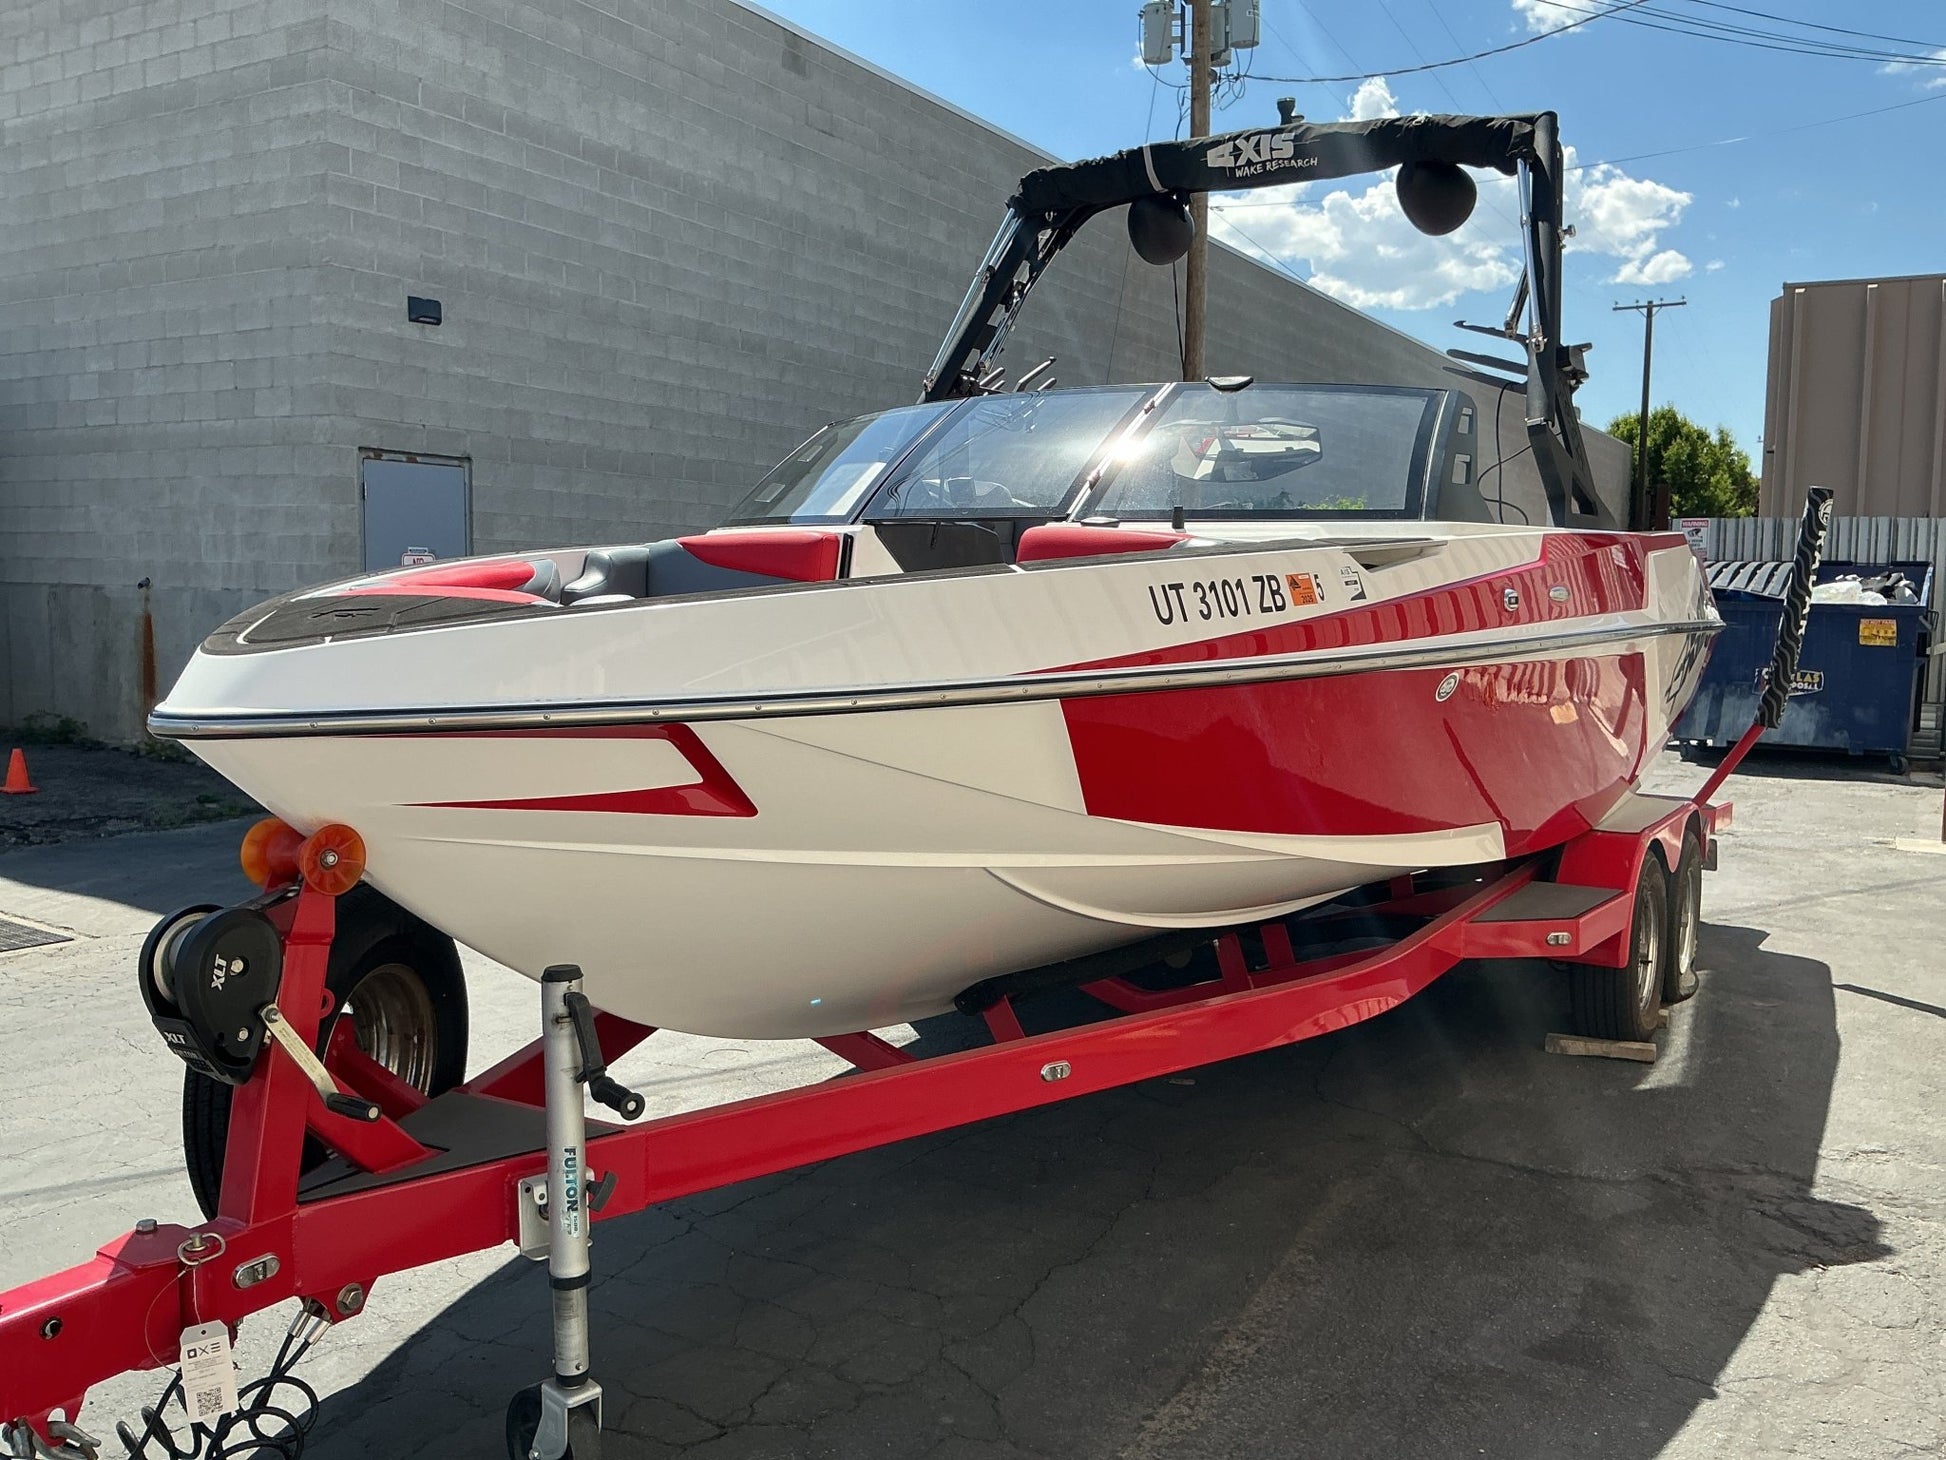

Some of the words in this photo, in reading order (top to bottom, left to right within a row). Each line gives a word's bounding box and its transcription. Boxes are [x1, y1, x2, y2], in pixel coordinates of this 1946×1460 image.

[1207, 133, 1296, 168] AXIS
[1235, 164, 1264, 178] WAKE
[1266, 157, 1318, 172] RESEARCH
[1148, 582, 1188, 626] UT
[1193, 578, 1251, 621] 3101
[1252, 574, 1287, 614] ZB
[211, 954, 227, 991] XLT
[164, 1031, 186, 1045] XLT
[564, 1147, 579, 1212] FULTON
